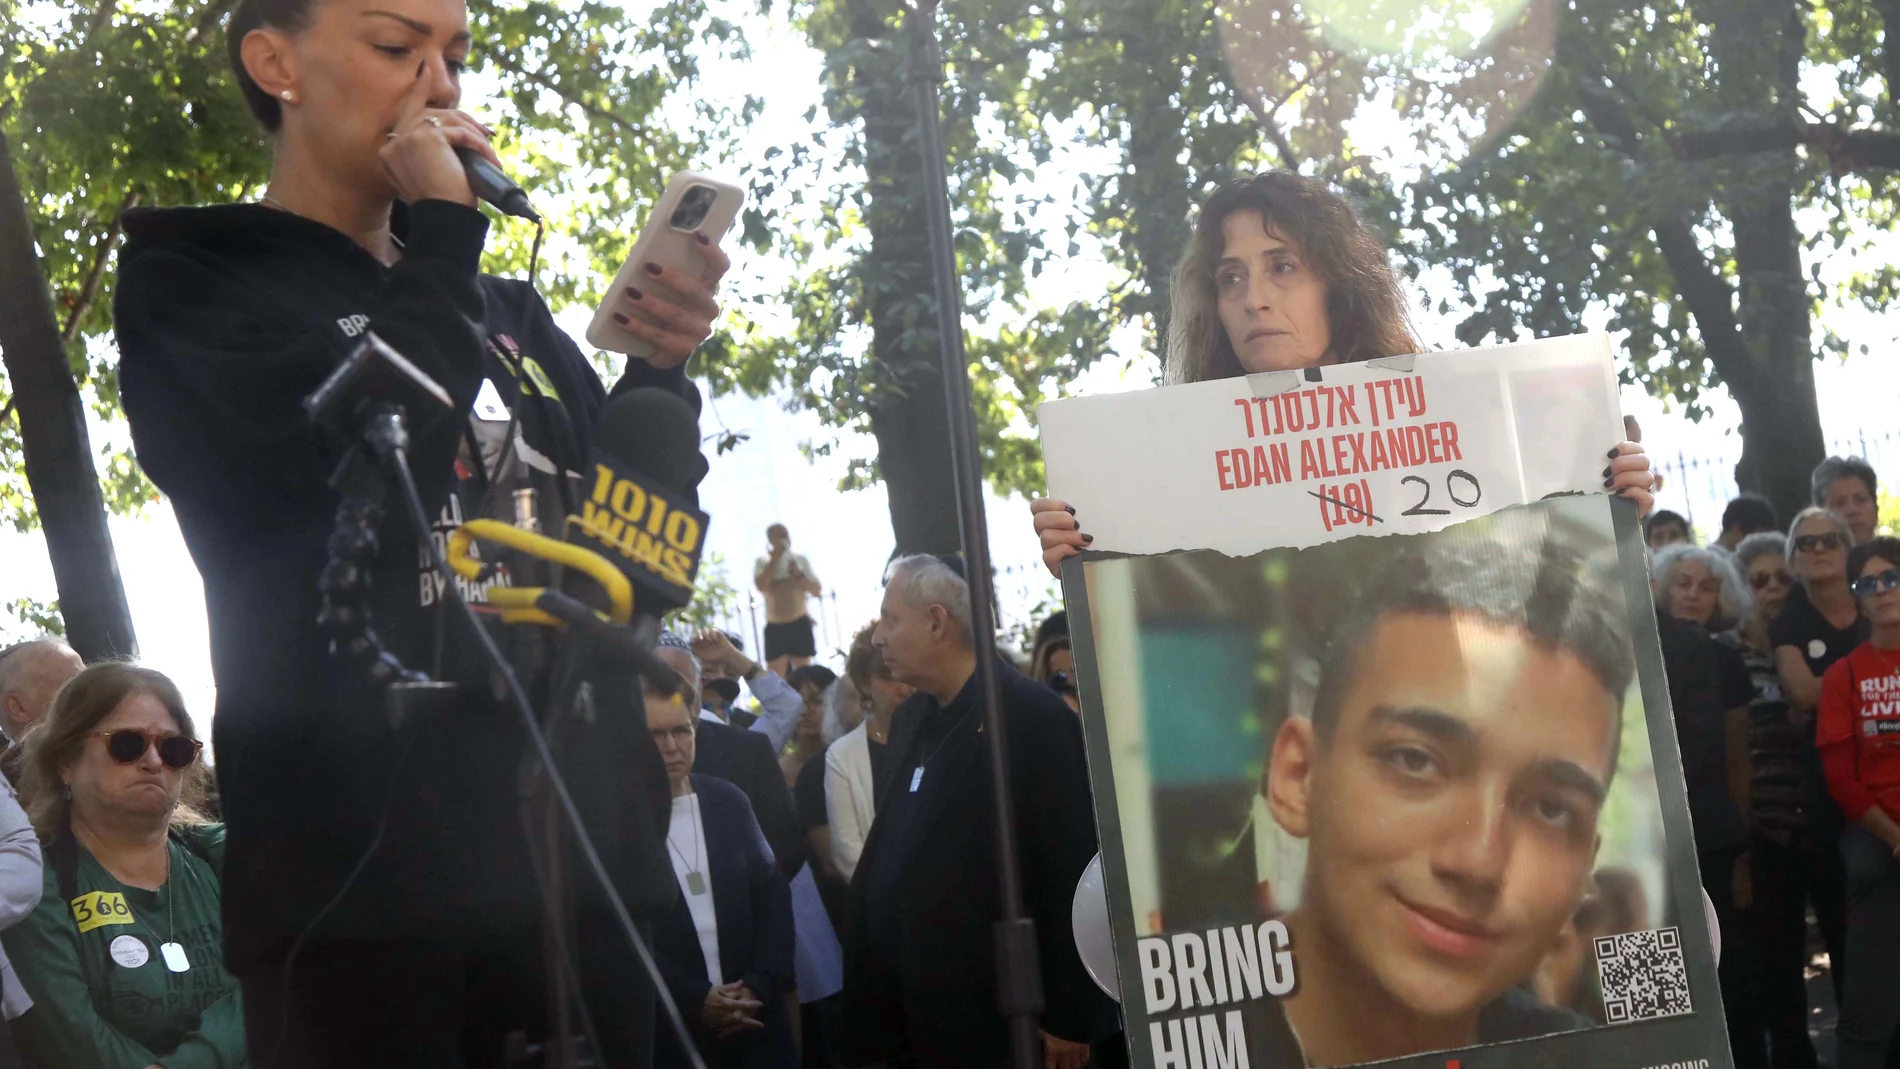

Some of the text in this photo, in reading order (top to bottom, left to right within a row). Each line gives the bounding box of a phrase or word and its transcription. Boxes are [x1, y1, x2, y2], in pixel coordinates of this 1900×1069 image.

[1234, 376, 1426, 438] עידן אלכסנדר
[1215, 421, 1462, 491] EDAN ALEXANDER
[591, 463, 699, 552] 1010
[1319, 479, 1373, 532] (19)
[1401, 469, 1481, 516] 20
[583, 500, 692, 587] WINS
[1861, 675, 1900, 692] RUN
[72, 895, 128, 923] 366
[1137, 920, 1295, 1015] BRING
[1149, 1010, 1250, 1069] HIM
